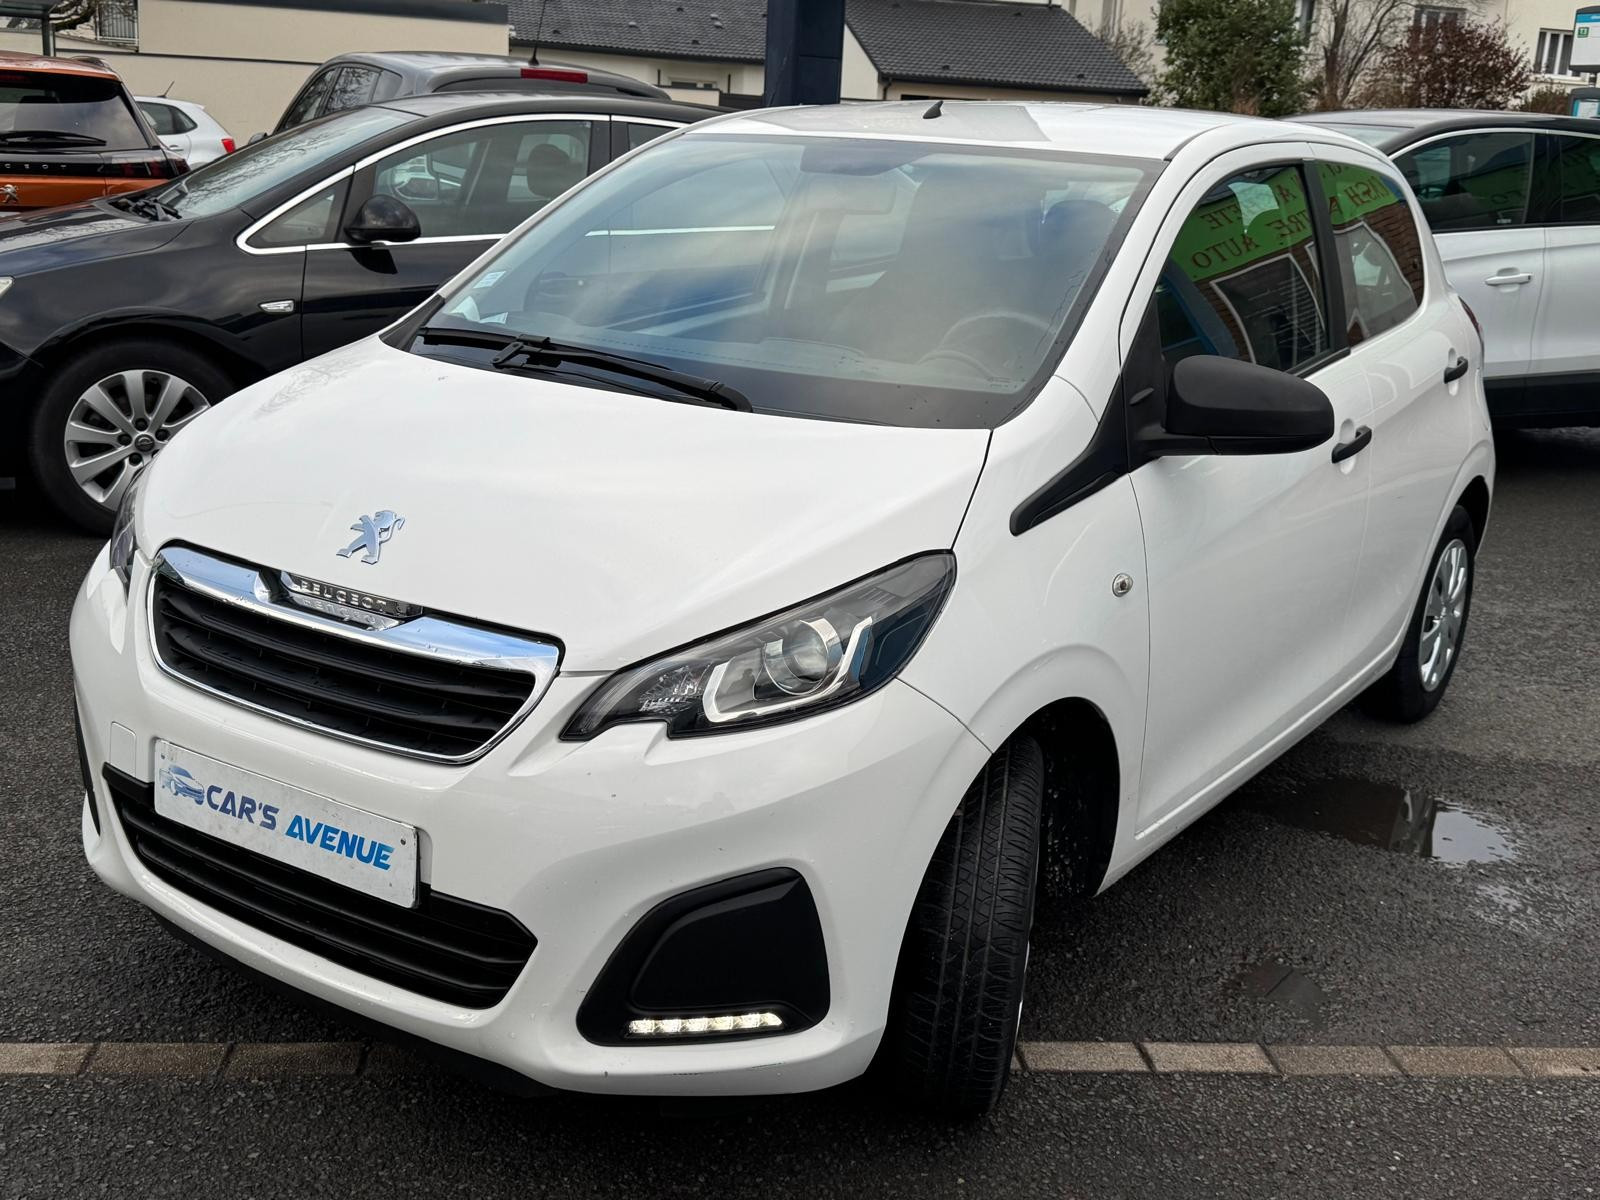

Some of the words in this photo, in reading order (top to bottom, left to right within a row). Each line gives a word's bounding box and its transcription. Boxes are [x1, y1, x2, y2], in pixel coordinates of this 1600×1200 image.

[299, 580, 387, 612] PEUGEOT
[206, 785, 280, 831] CAR'S
[285, 815, 395, 871] AVENUE
